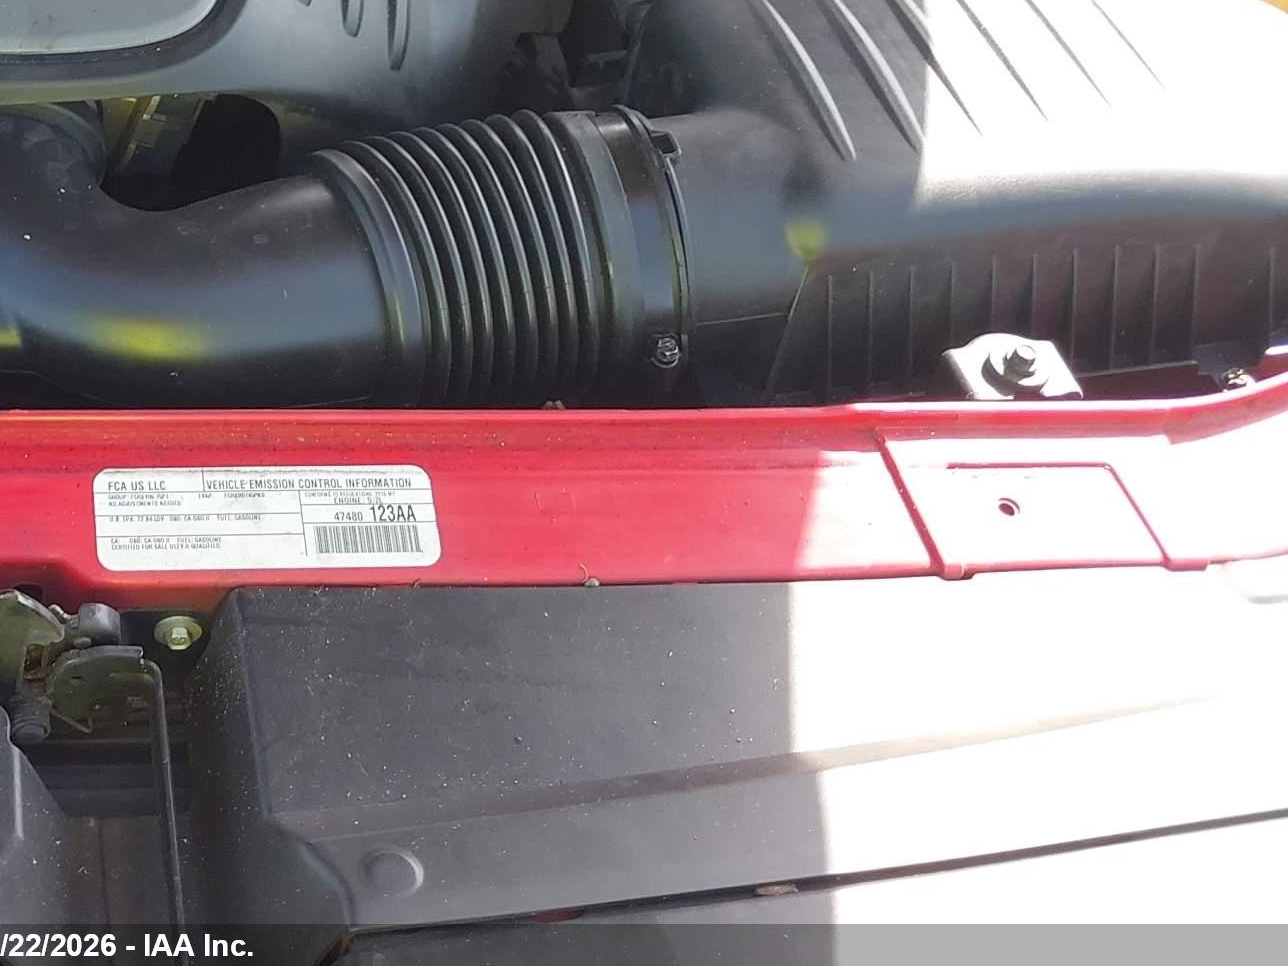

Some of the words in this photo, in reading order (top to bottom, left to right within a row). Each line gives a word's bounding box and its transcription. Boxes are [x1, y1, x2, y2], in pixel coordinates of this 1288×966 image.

[107, 481, 127, 491] FCA
[131, 481, 145, 491] US
[148, 481, 166, 491] LLC
[206, 480, 246, 490] VEHICLE
[249, 478, 295, 489] EMISSION
[298, 478, 343, 489] CONTROL
[345, 477, 412, 488] INFORMATION
[369, 505, 417, 523] 123AA
